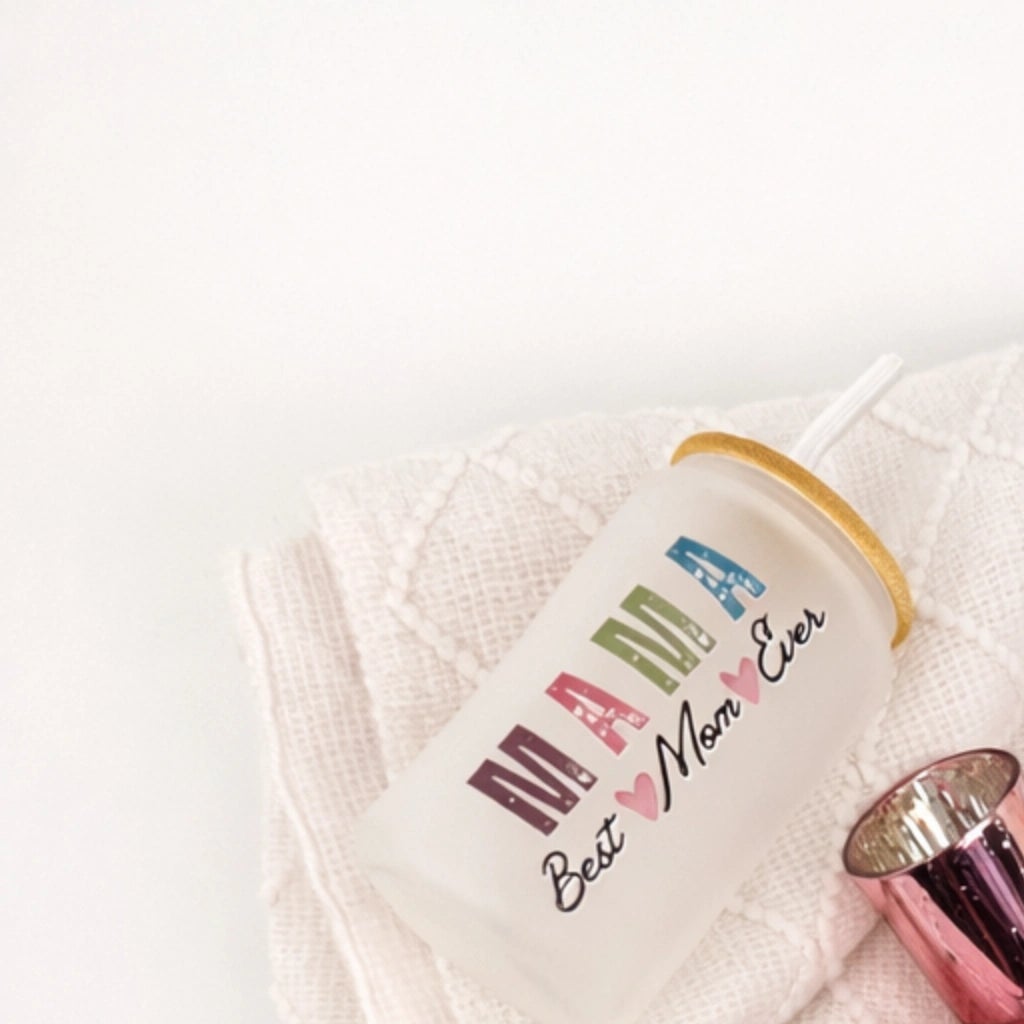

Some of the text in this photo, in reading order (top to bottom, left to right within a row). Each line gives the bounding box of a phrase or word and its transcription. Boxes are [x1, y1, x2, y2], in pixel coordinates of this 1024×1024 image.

[466, 535, 767, 837] MAMA
[542, 608, 825, 912] Best Mom Ever
